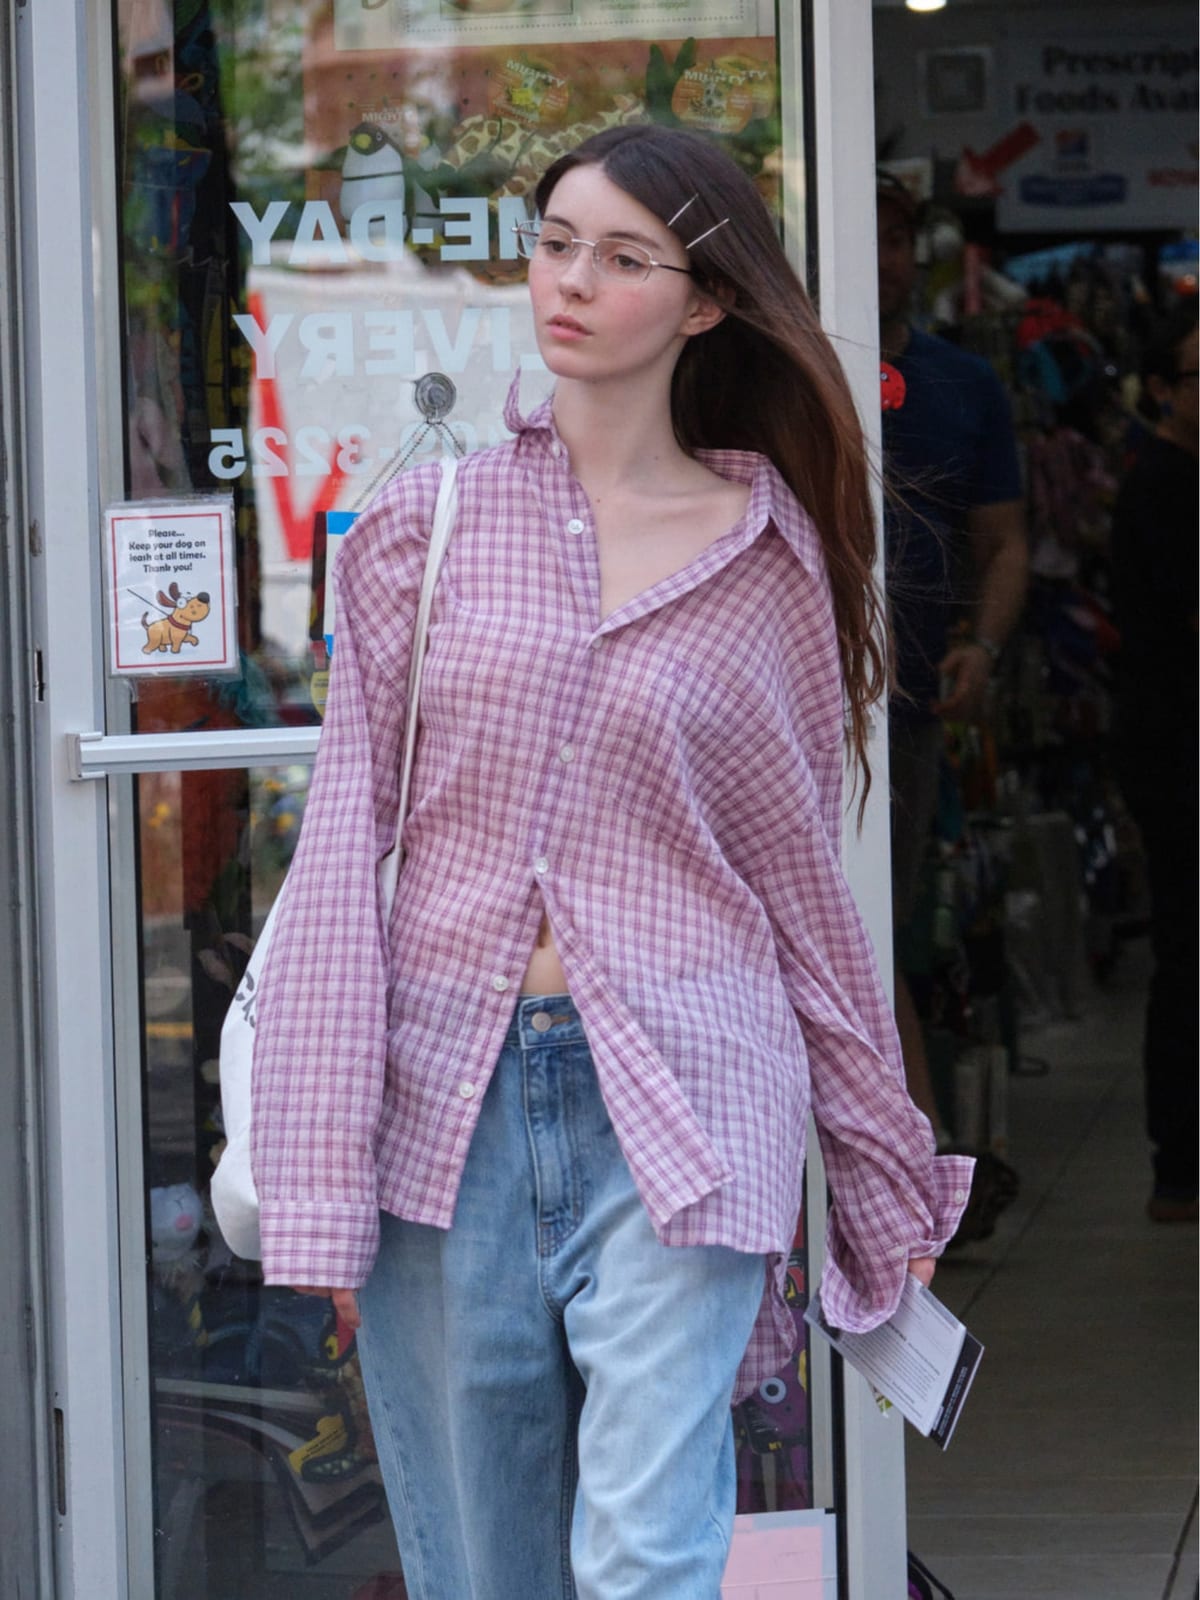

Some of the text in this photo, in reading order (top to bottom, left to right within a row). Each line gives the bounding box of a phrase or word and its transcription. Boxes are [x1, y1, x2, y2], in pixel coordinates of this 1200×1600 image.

[129, 540, 206, 551] Keep your dog on
[129, 553, 152, 562] leash
[165, 552, 177, 560] all
[179, 551, 206, 560] times.
[143, 562, 193, 573] Thank you!
